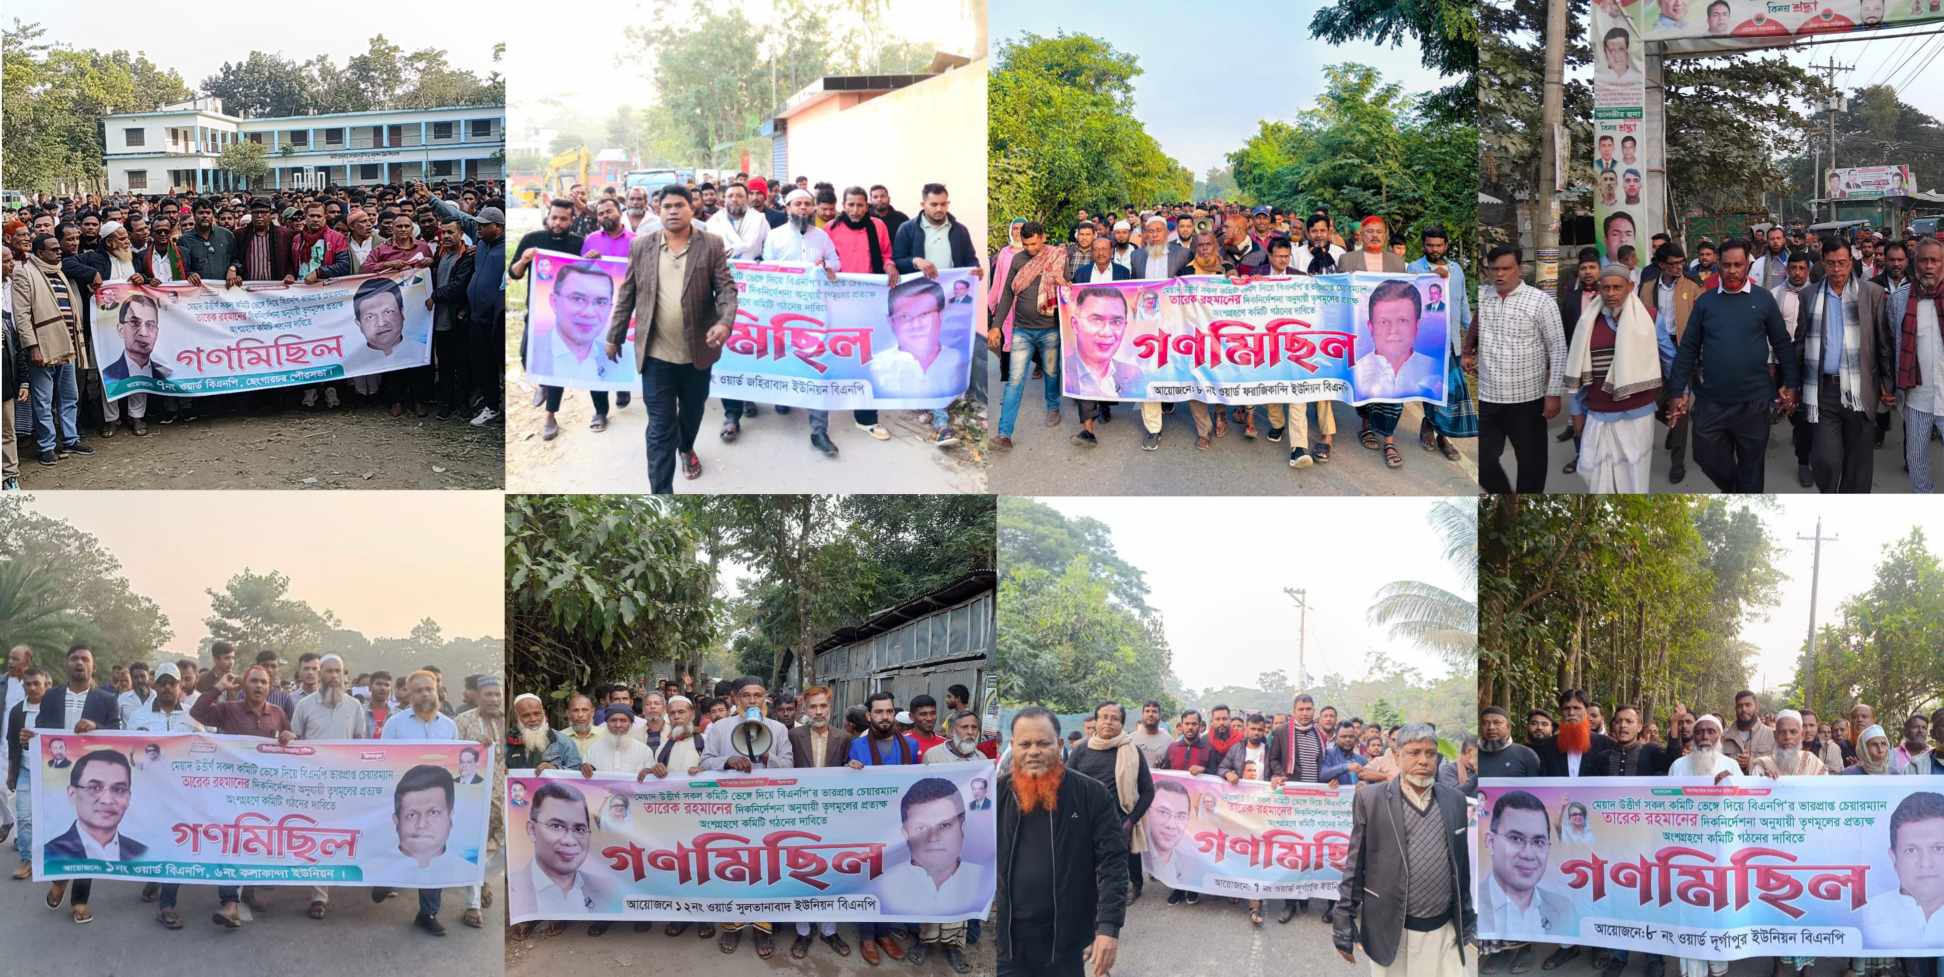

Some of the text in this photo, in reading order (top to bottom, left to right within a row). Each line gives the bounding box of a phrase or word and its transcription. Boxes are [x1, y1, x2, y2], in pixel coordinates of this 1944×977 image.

[1169, 295, 1197, 304] তারেক
[1200, 294, 1241, 305] রহমানের
[177, 334, 344, 372] গণমিছিল
[1134, 318, 1357, 374] গণমিছিল
[720, 374, 744, 387] ওয়ার্ড
[747, 375, 789, 392] জহিরাবাদ
[792, 379, 828, 395] ইউনিয়ন
[831, 381, 864, 396] বিএনপি
[1154, 386, 1195, 396] আয়োজনে:
[1196, 386, 1203, 394] ৮
[1207, 386, 1216, 398] নং
[1219, 386, 1239, 398] ওয়ার্ড
[1243, 383, 1288, 397] ফরাজিকান্দি
[1291, 382, 1321, 395] ইউনিয়ন
[181, 775, 209, 788] তারেক
[213, 776, 250, 789] রহমানের
[643, 802, 680, 815] তারেক
[683, 802, 732, 815] রহমানের
[1256, 804, 1292, 816] রহমানের
[1592, 800, 1617, 810] মেয়াদ
[1620, 798, 1641, 810] উত্তীর্ণ
[1644, 800, 1666, 810] সকল
[1669, 799, 1695, 811] কমিটি
[1723, 799, 1743, 811] দিয়ে
[1799, 800, 1835, 811] ভারপ্রাপ্ত
[1839, 800, 1887, 811] চেয়ারম্যান
[1601, 812, 1876, 830] তারেক রহমানের দিকনির্দেশনা অনুযায়ী তৃণমূলের প্রত্যক্ষ
[172, 812, 361, 863] গণমিছিল
[1706, 830, 1734, 843] কমিটি
[1738, 830, 1769, 843] গঠনের
[1772, 830, 1806, 843] দাবিতে
[1194, 828, 1350, 872] গণমিছি
[601, 830, 887, 890] গণমিছিল
[1559, 847, 1871, 919] গণমিছিল
[626, 898, 876, 916] আয়োজনে ১২নং ওয়ার্ড সুলতানাবাদ ইউনিয়ন বিএনপি
[1661, 931, 1675, 944] নং
[1678, 930, 1706, 947] ওয়ার্ড
[1751, 929, 1797, 945] ইউনিয়ন
[1801, 928, 1845, 946] বিএনপি
